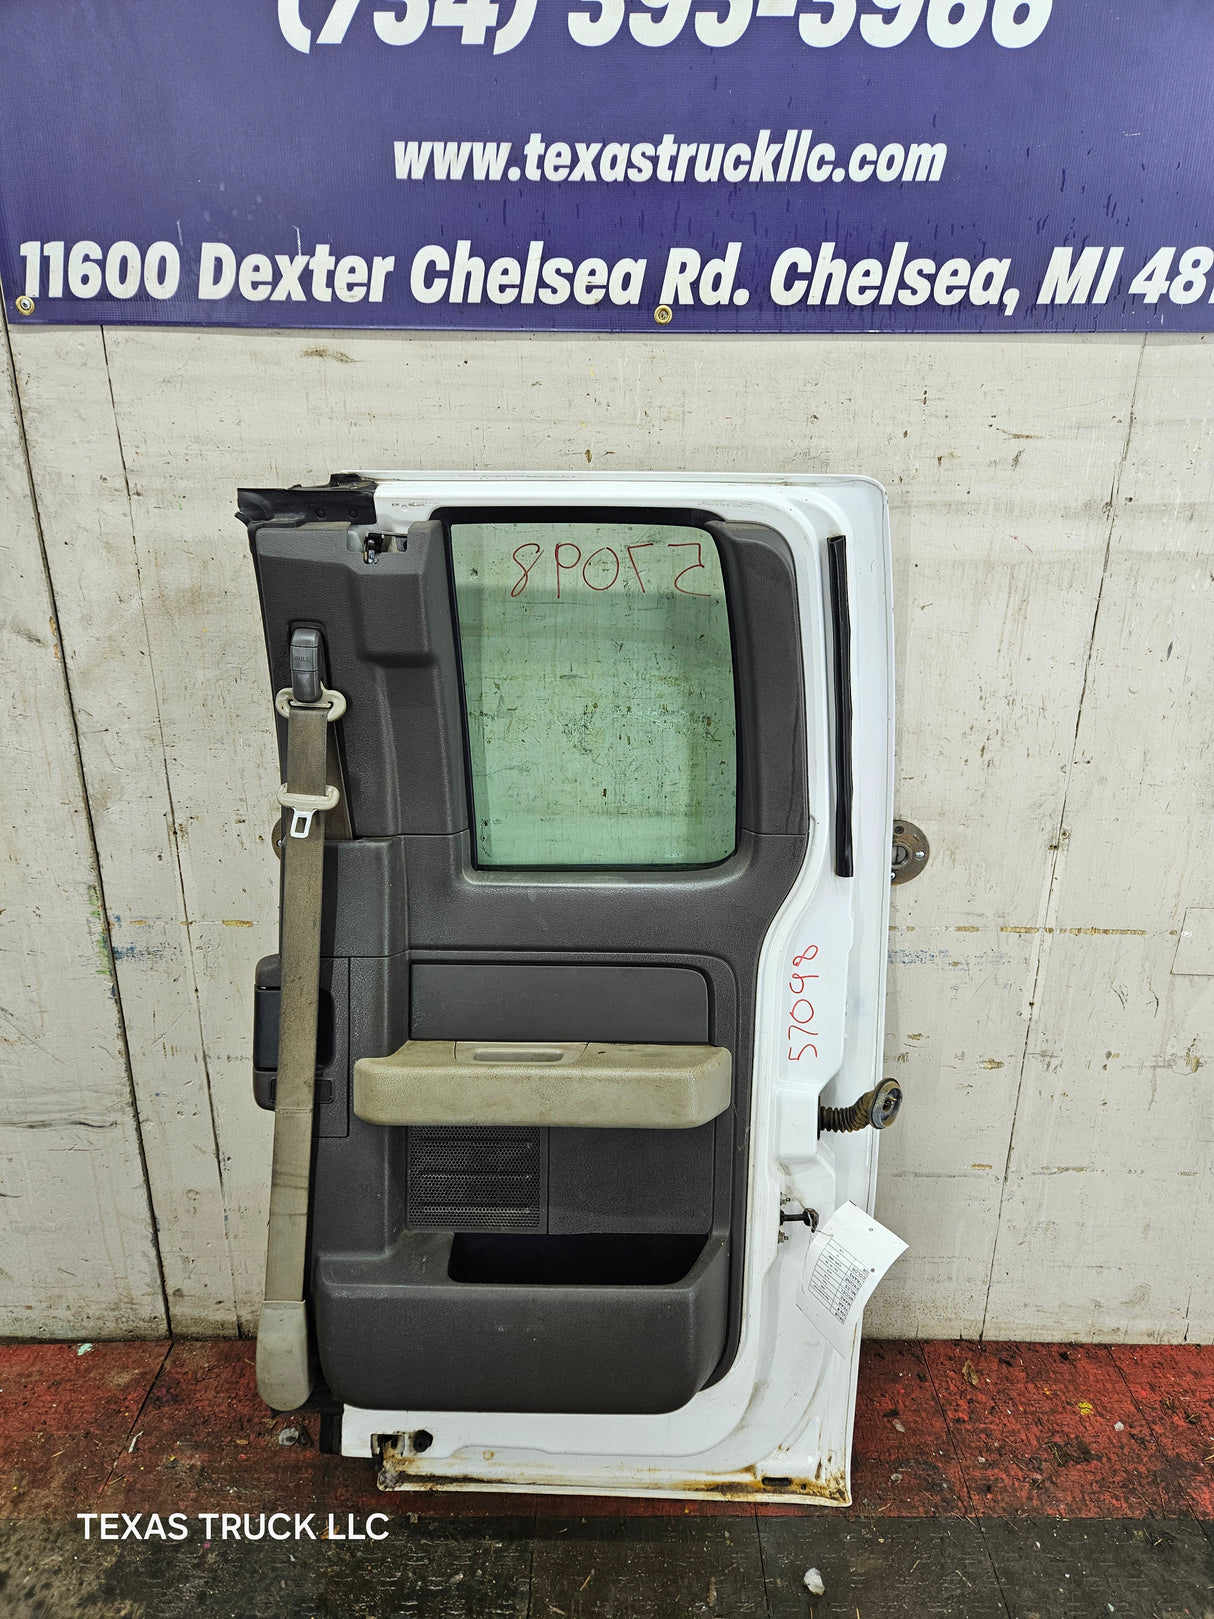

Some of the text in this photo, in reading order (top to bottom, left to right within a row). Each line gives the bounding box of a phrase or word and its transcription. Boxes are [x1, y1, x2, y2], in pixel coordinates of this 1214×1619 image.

[394, 129, 948, 182] www.texastruckllc.com
[20, 239, 1214, 316] 11600 Dexter Chelsea Rd. Chelsea, MI 48
[787, 944, 820, 1061] 57098
